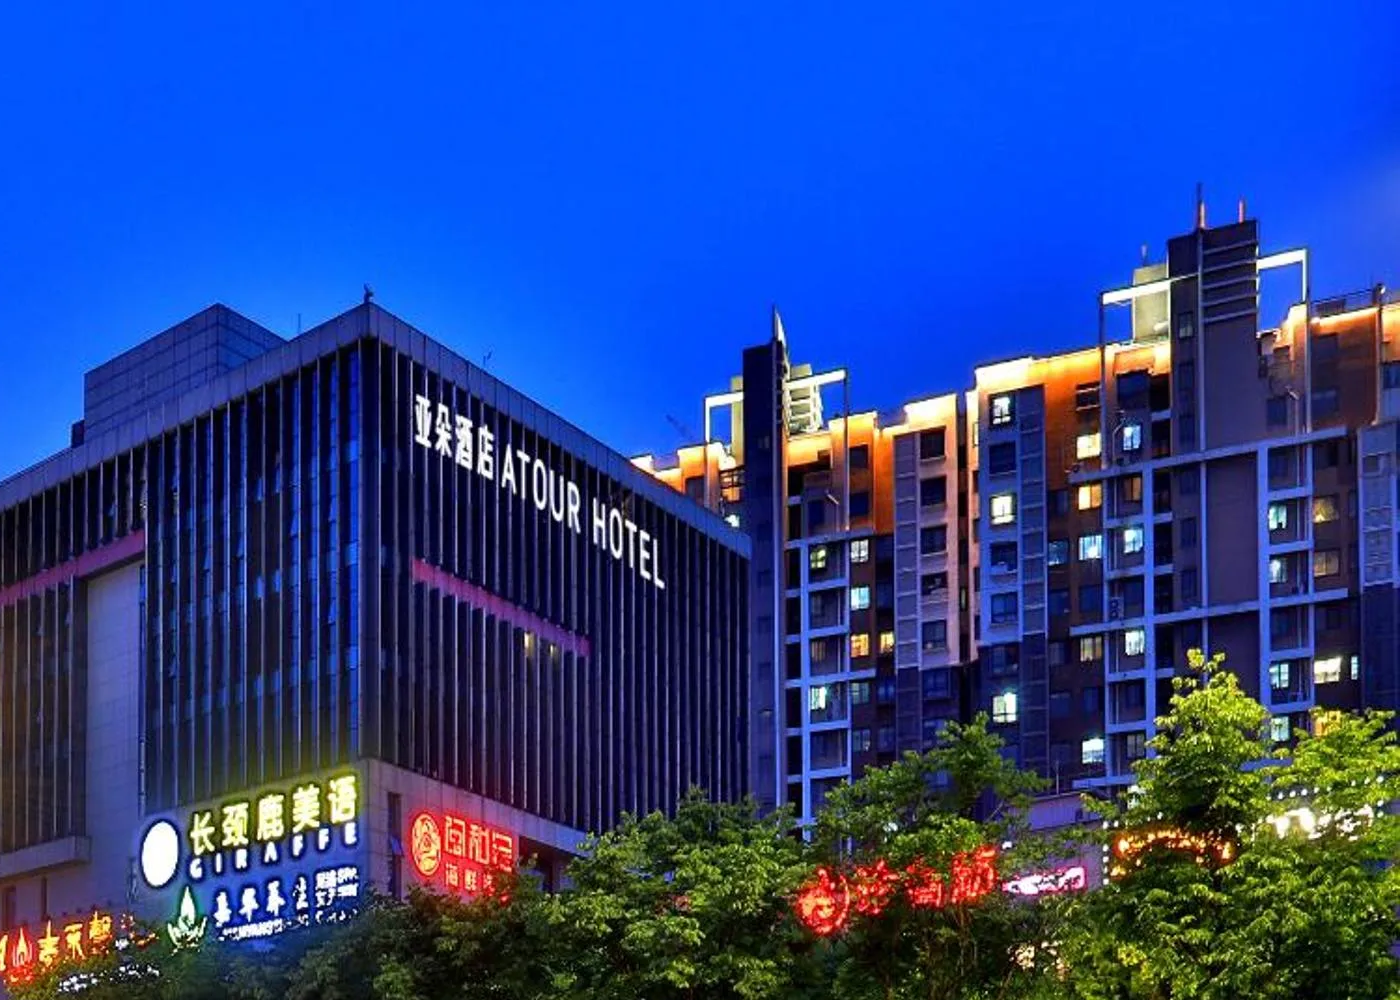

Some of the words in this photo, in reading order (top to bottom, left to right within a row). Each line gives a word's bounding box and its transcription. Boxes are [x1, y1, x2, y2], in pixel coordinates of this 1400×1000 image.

[414, 393, 495, 481] 亚朵酒店
[501, 443, 582, 535] ATOUR
[592, 496, 666, 590] HOTEL
[189, 822, 358, 880] GIRAFFE
[190, 775, 357, 856] 长颈鹿美语
